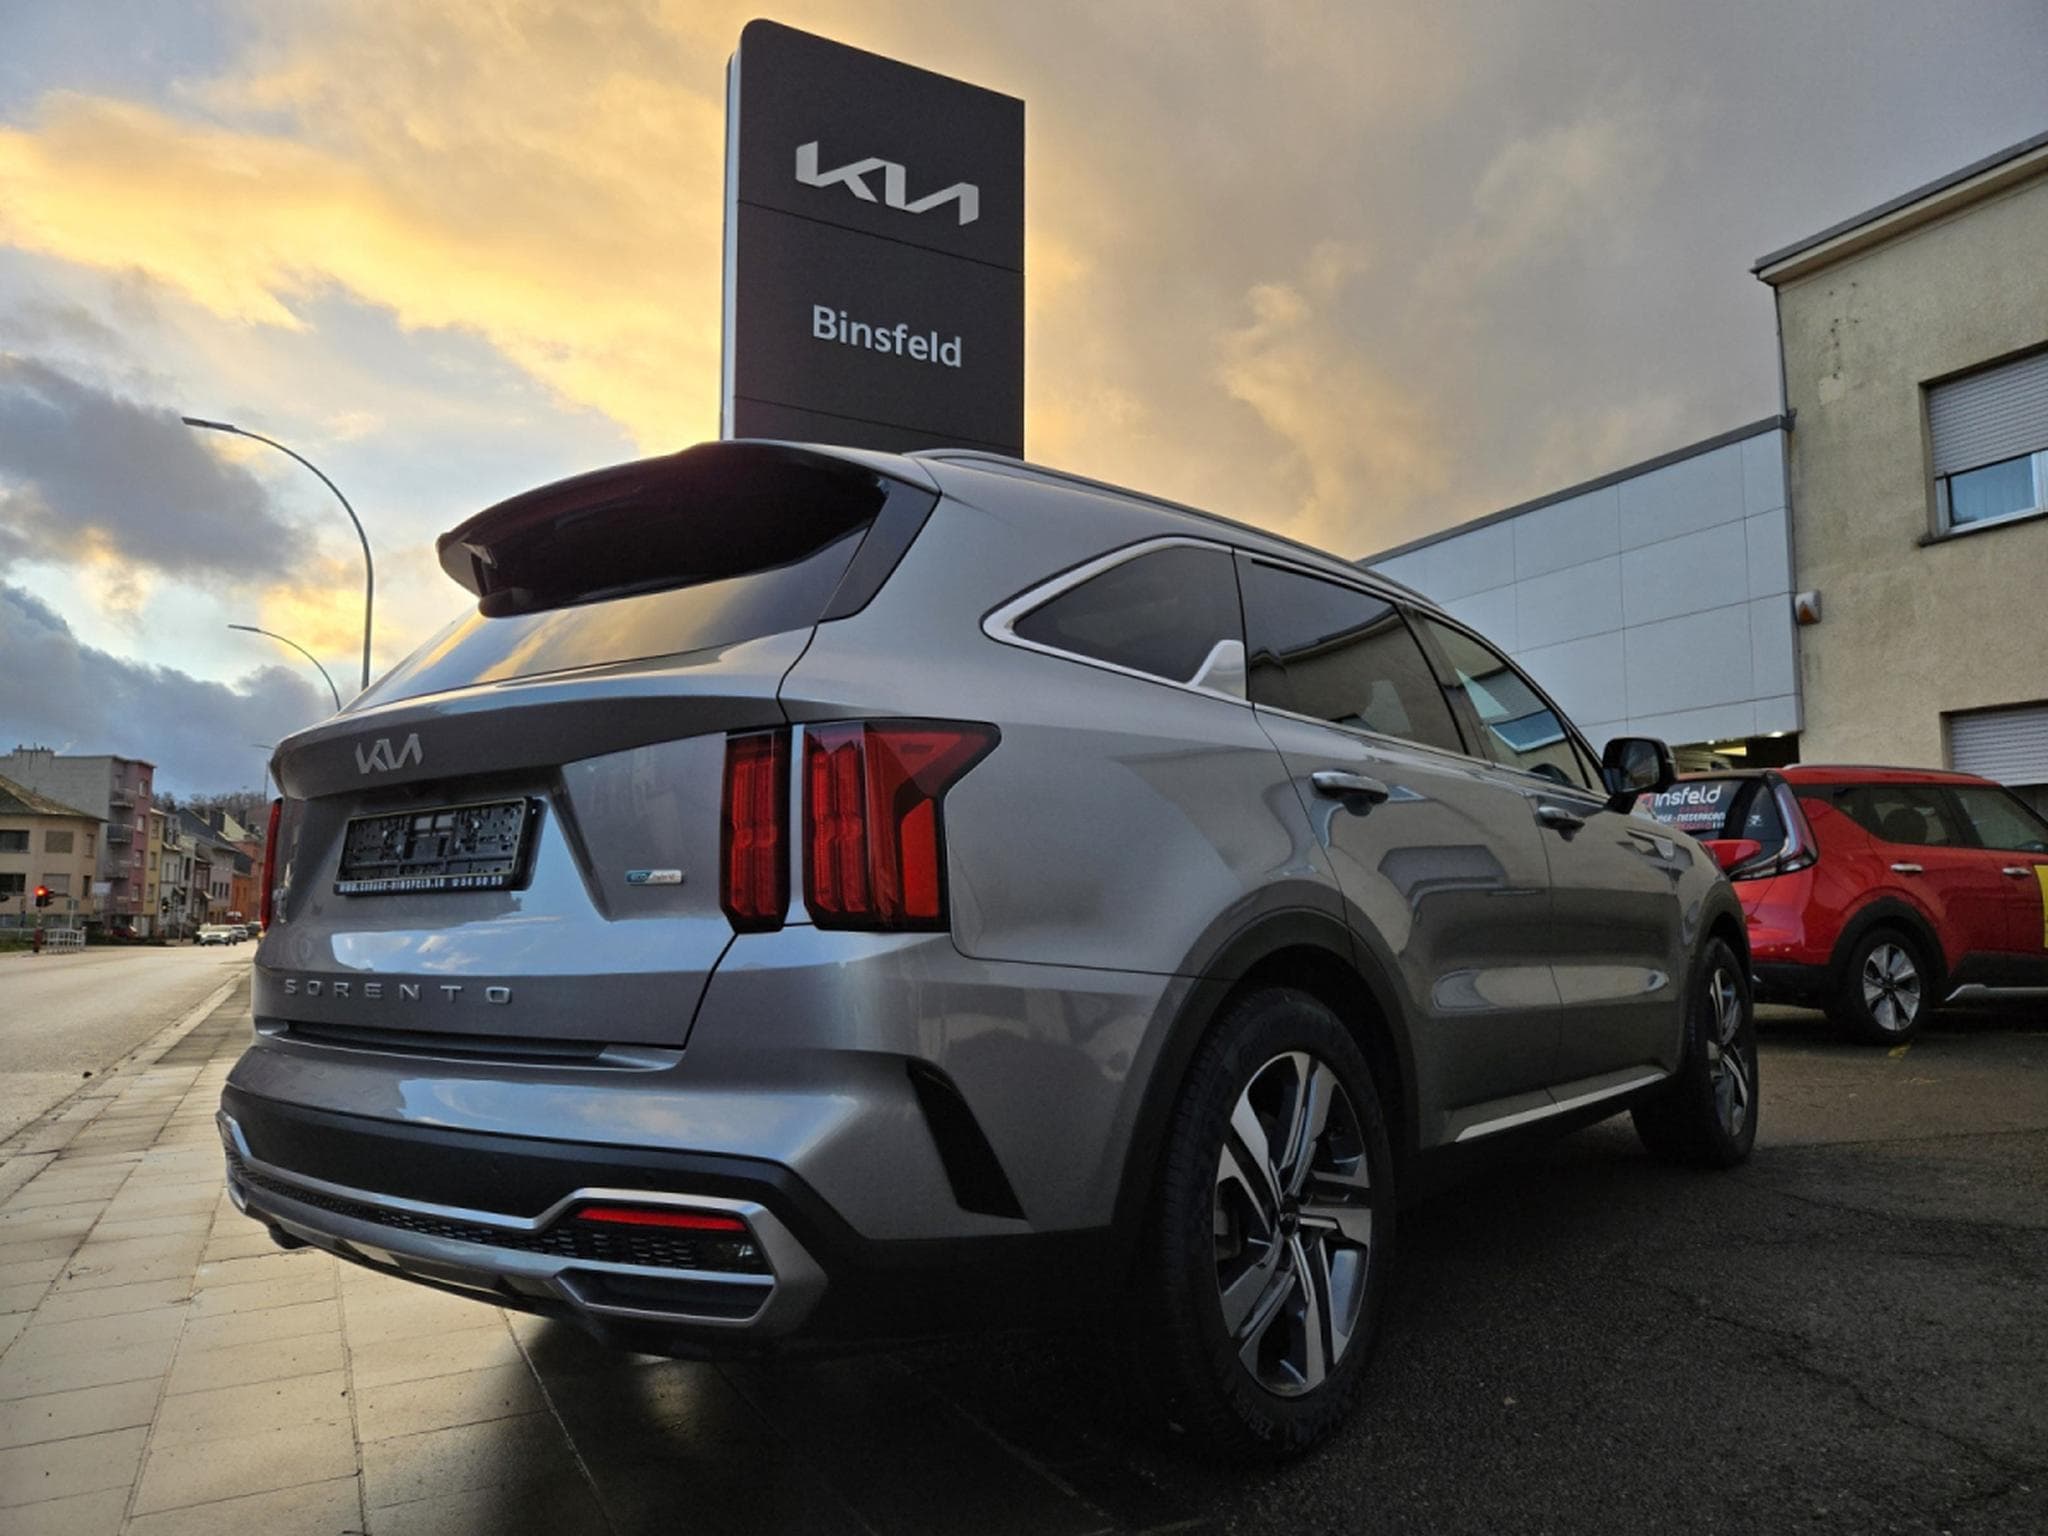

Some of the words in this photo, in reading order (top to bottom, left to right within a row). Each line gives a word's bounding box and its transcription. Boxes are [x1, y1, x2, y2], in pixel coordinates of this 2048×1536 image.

[796, 141, 979, 226] KIA
[813, 304, 962, 367] Binsfeld
[355, 733, 423, 775] KIA
[1654, 785, 1722, 807] insfeld
[285, 978, 512, 1004] SORENTO
